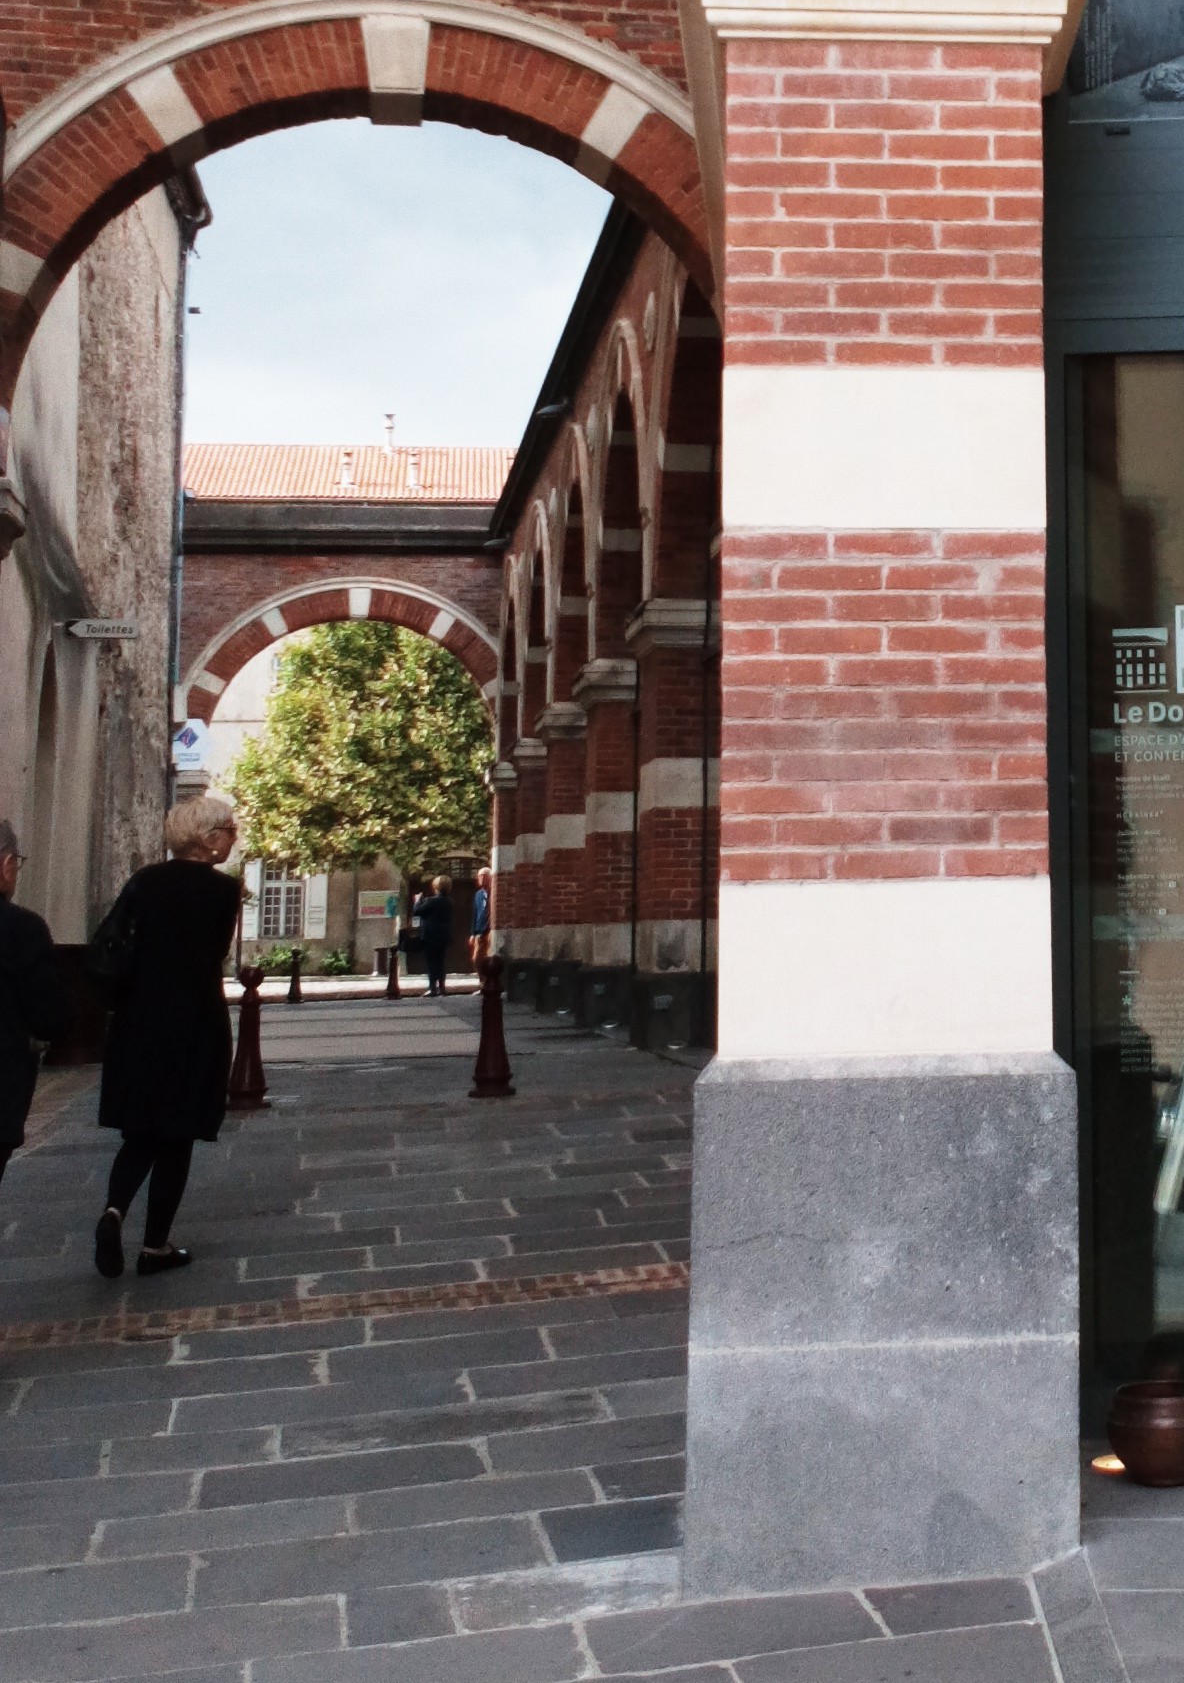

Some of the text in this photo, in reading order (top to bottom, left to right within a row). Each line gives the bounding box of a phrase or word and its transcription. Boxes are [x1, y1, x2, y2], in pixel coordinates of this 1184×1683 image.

[85, 623, 134, 634] Toilettes
[1113, 702, 1143, 724] Le
[1114, 734, 1164, 747] ESPACE
[1114, 751, 1128, 763] ET
